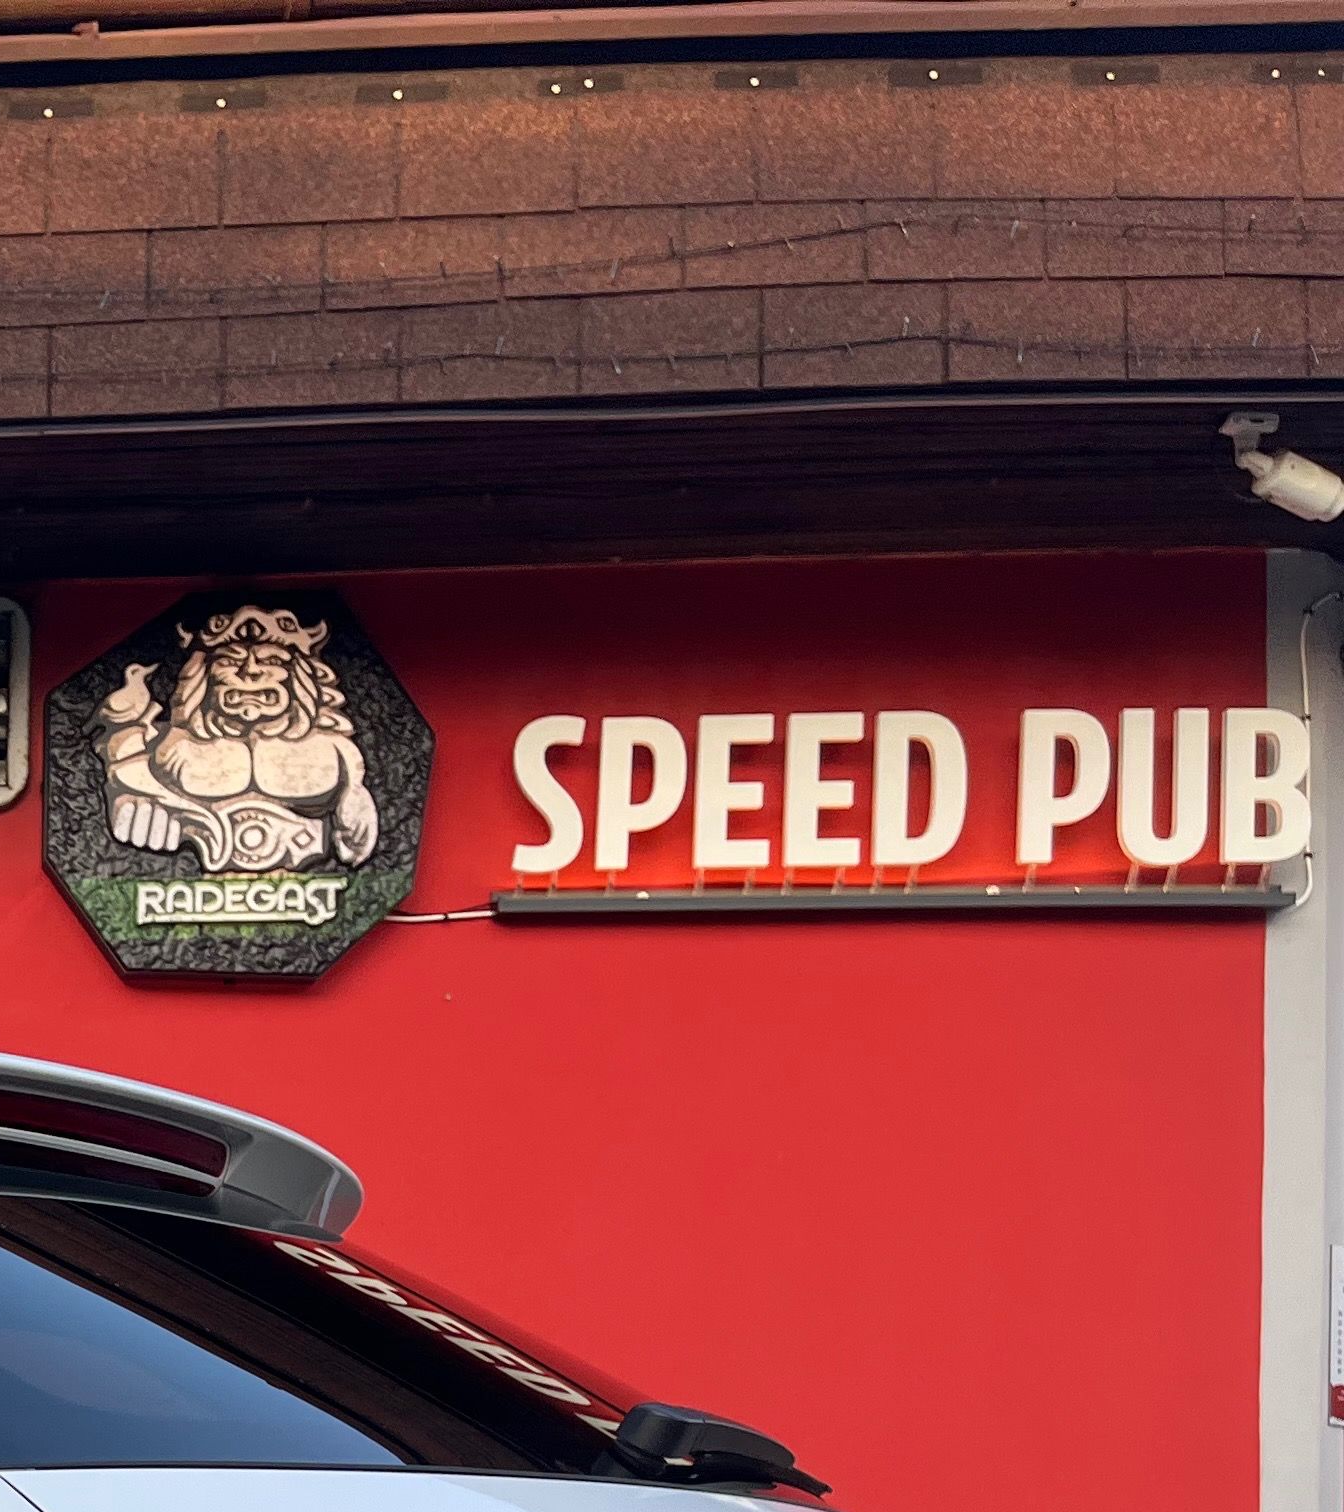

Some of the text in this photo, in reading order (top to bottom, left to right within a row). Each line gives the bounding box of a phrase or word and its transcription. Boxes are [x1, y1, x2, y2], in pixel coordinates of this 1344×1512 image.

[512, 707, 1312, 874] SPEED PUB
[137, 877, 348, 926] RADEGAST
